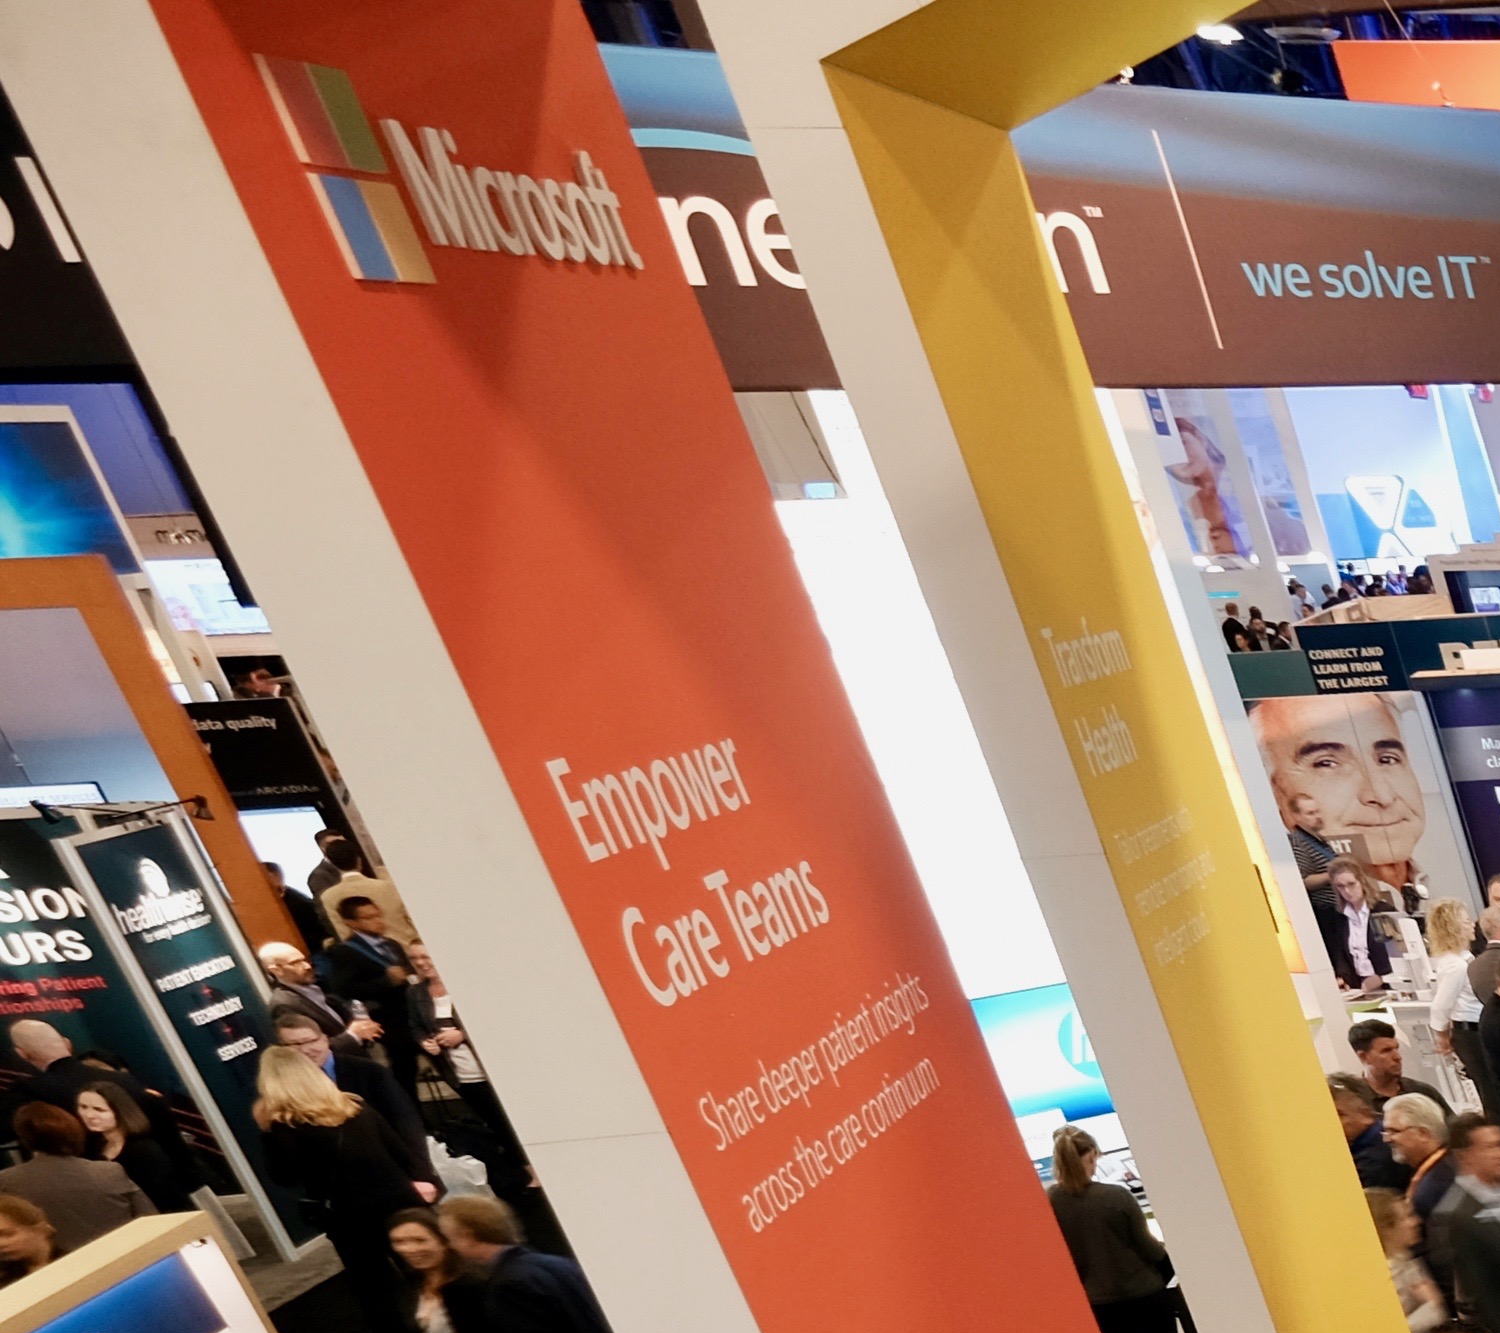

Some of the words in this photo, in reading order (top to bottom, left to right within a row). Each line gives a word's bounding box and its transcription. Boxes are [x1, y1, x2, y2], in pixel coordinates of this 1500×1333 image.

[378, 118, 644, 271] Microsoft
[1241, 259, 1311, 299] we
[1320, 250, 1434, 301] solve
[1442, 255, 1477, 301] IT
[1040, 616, 1132, 688] Transform
[1309, 649, 1358, 660] CONNECT
[1361, 647, 1384, 658] AND
[1312, 664, 1348, 674] LEARN
[1351, 661, 1382, 672] FROM
[1318, 678, 1338, 689] THE
[1340, 675, 1388, 688] LARGEST
[226, 716, 277, 731] quality
[1074, 704, 1138, 778] Health
[546, 738, 751, 870] Empower
[622, 906, 729, 1006] Care
[703, 860, 829, 962] Teams
[42, 976, 107, 991] Patient
[156, 969, 191, 992] PATIENT
[191, 956, 235, 983] EDUCATION
[189, 997, 243, 1026] TECHNOLOGY
[217, 1037, 257, 1061] SERVICES
[699, 1084, 766, 1151] Share
[757, 1046, 825, 1108] deeper
[819, 993, 878, 1086] patient
[872, 972, 930, 1035] insights
